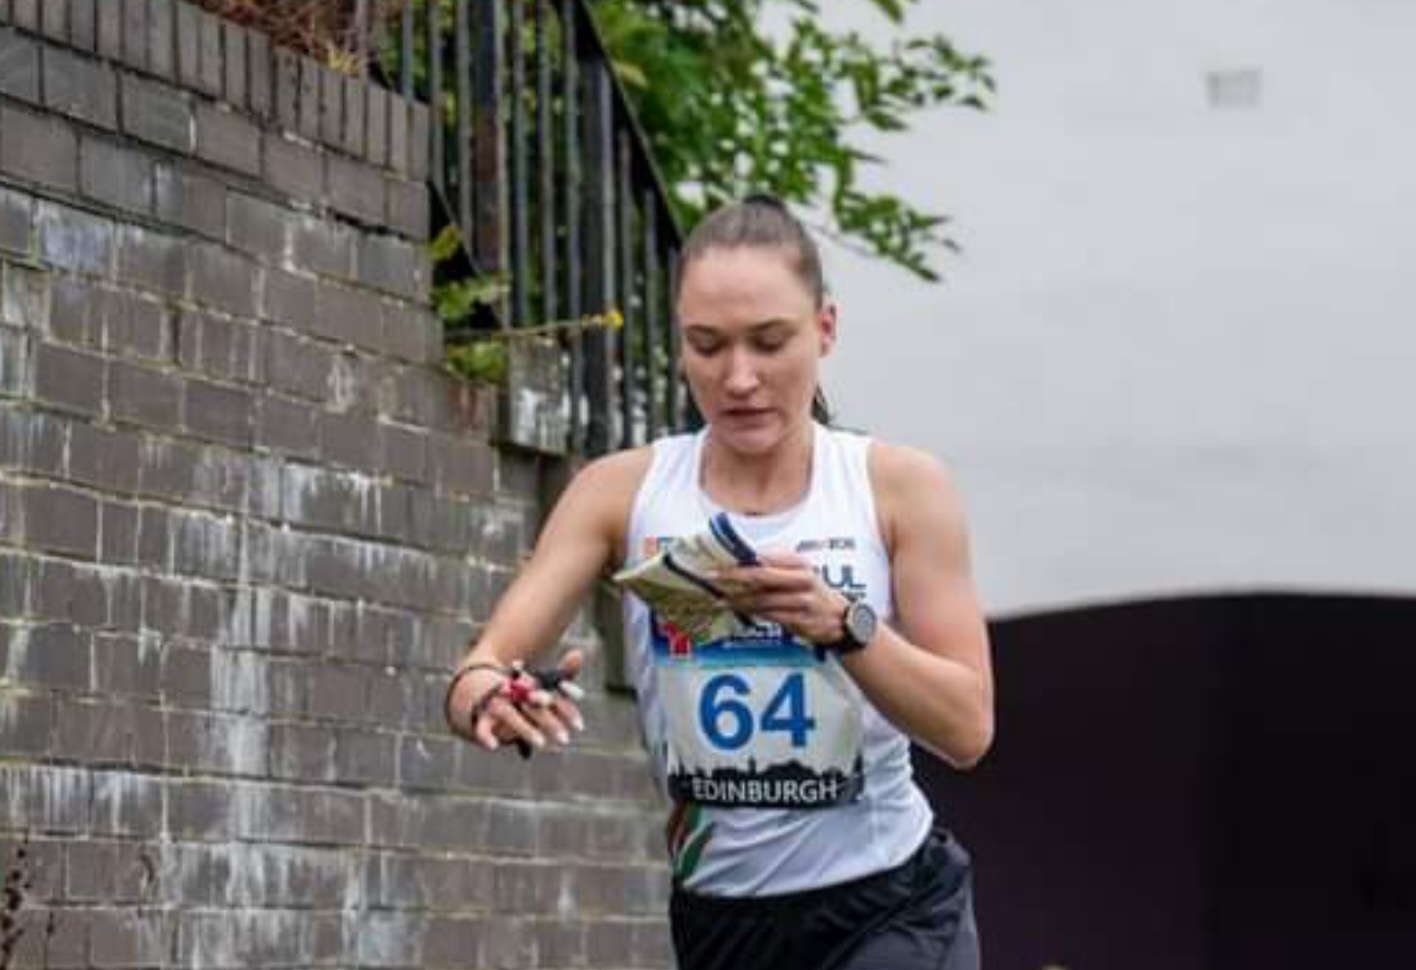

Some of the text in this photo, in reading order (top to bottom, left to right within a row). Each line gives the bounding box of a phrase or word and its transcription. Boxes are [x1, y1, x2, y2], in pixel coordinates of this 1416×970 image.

[814, 564, 868, 590] UL
[698, 673, 816, 751] 64
[692, 778, 838, 804] EDINBURGH
